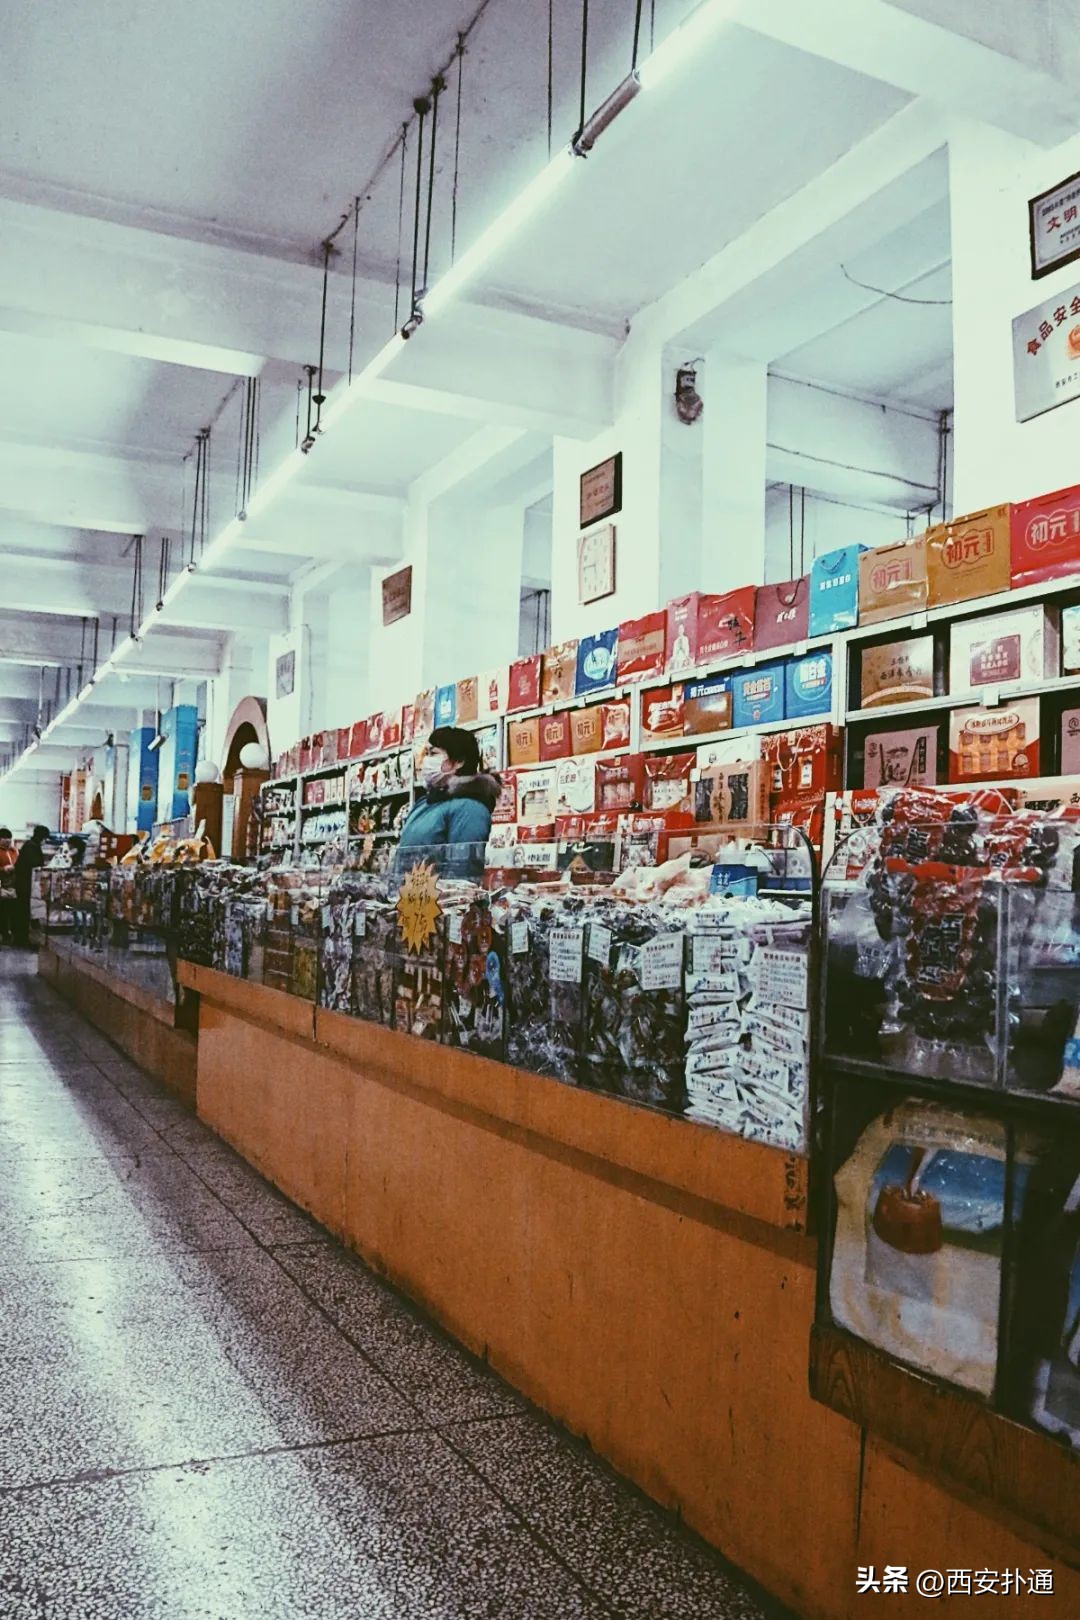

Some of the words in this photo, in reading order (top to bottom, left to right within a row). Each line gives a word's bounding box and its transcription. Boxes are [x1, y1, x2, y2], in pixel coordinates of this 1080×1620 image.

[1046, 205, 1077, 233] 文明
[1027, 296, 1080, 356] 食品安全
